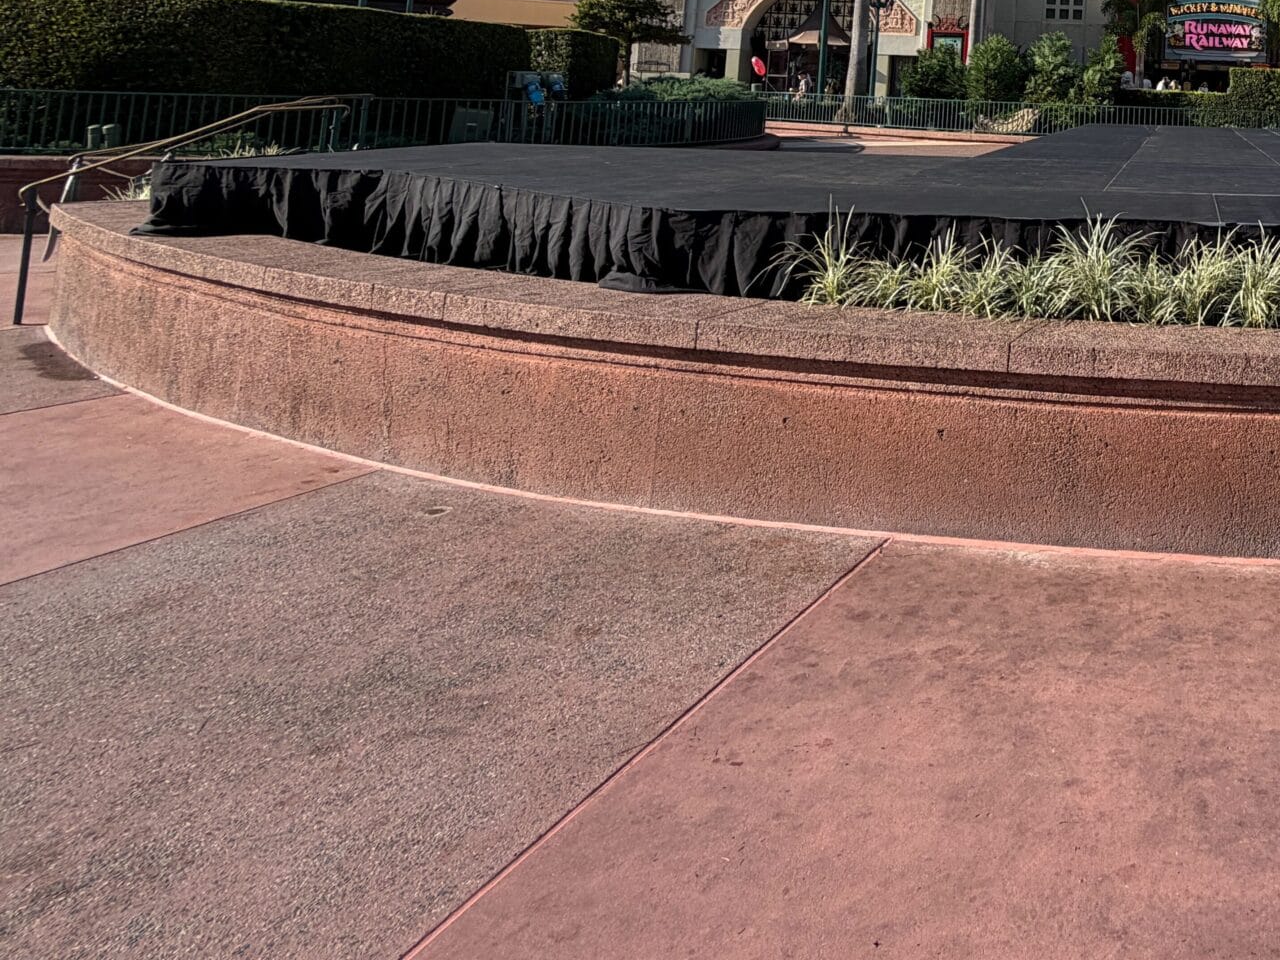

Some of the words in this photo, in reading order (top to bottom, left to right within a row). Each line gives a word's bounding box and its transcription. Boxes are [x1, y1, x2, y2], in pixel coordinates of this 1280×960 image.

[1170, 3, 1208, 15] MICKEY
[1211, 3, 1218, 12] &
[1184, 21, 1252, 35] RUNAWAY
[1185, 34, 1250, 50] RAILWAY
